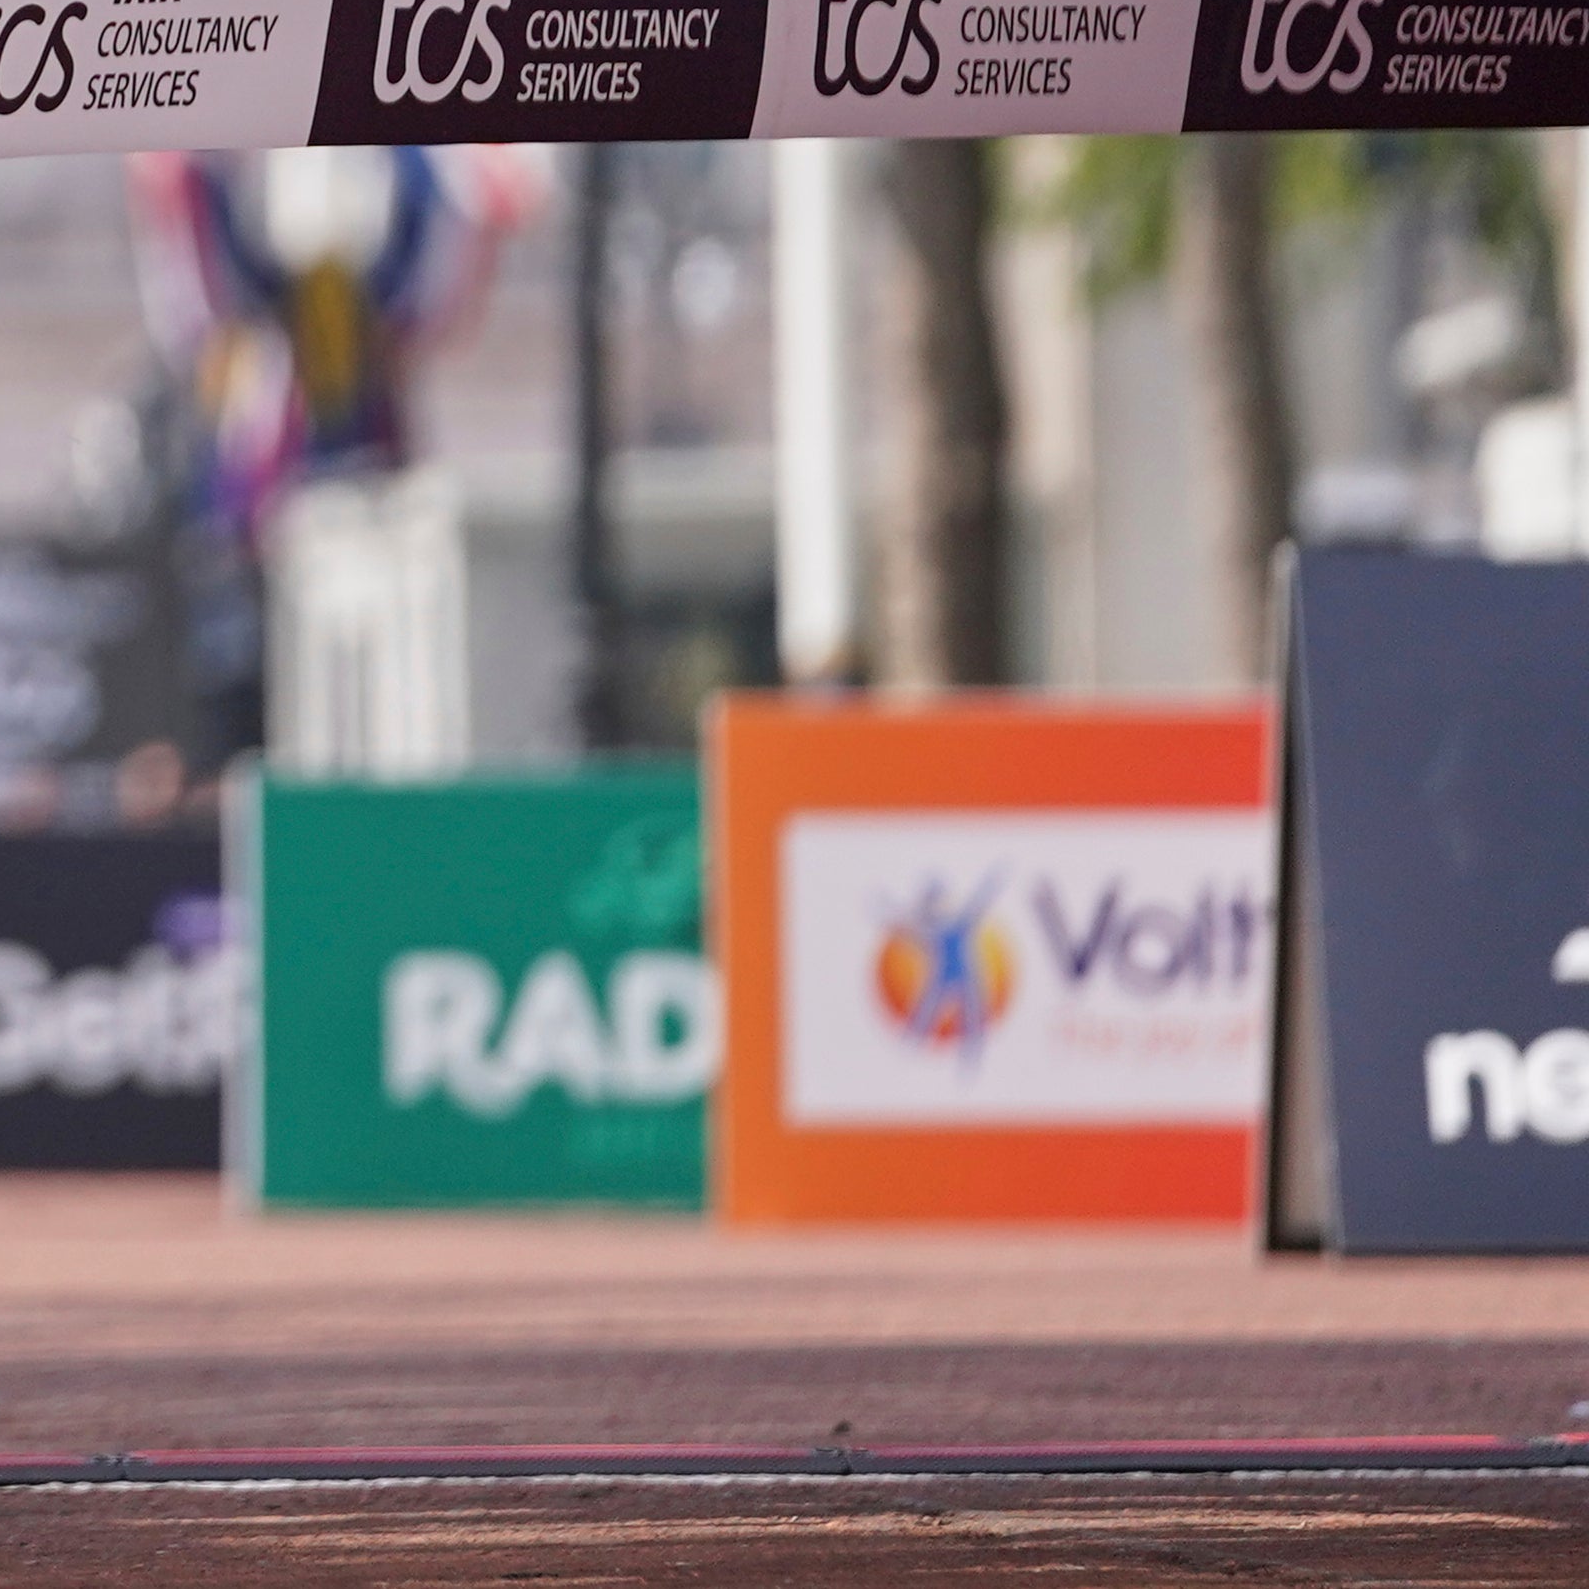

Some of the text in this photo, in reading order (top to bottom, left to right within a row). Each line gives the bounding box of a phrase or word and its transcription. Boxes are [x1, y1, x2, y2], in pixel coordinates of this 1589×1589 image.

[97, 14, 279, 58] CONSULTANCY
[525, 8, 721, 50] CONSULTANCY
[960, 4, 1147, 44] CONSULTANCY
[1396, 4, 1589, 46] CONSULTANCY
[82, 69, 200, 111] SERVICES
[516, 61, 642, 102] SERVICES
[954, 57, 1073, 96] SERVICES
[1382, 54, 1512, 94] SERVICES
